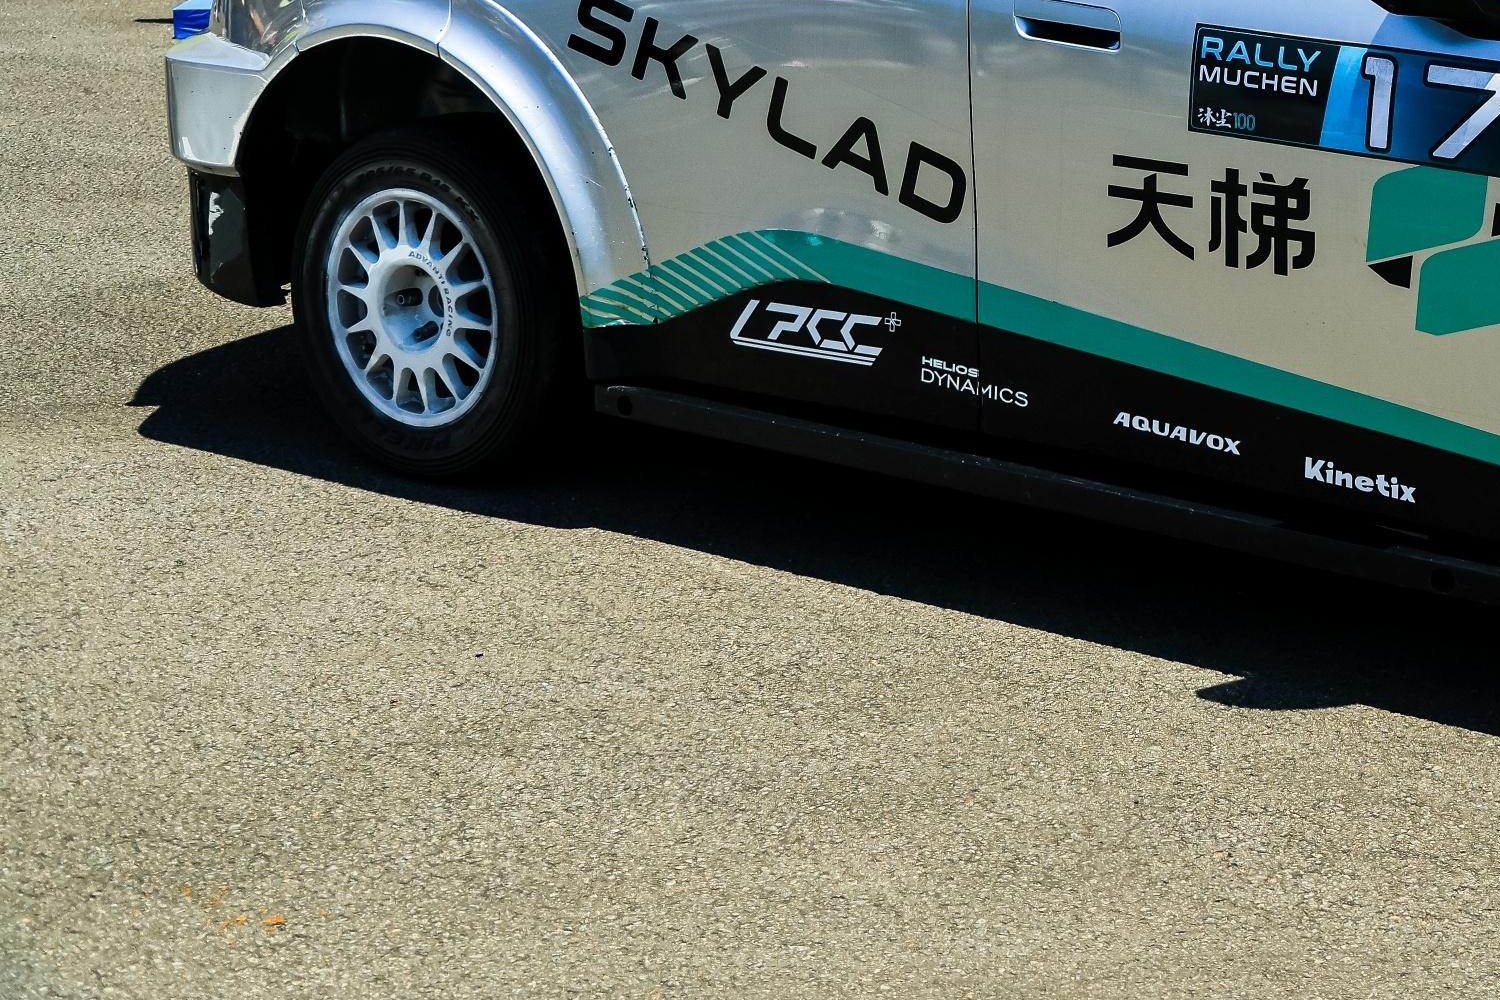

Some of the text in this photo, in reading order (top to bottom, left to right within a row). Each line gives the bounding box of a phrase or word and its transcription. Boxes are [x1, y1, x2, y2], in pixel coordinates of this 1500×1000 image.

[1200, 36, 1322, 72] RALLY
[1199, 64, 1319, 97] MUCHEN
[1107, 153, 1316, 277] 天梯
[443, 287, 454, 337] RACING
[920, 367, 1029, 408] DYNAMICS
[921, 355, 980, 379] HELIOS
[1112, 411, 1241, 456] AQUAVOX
[1304, 456, 1416, 504] Kinetix
